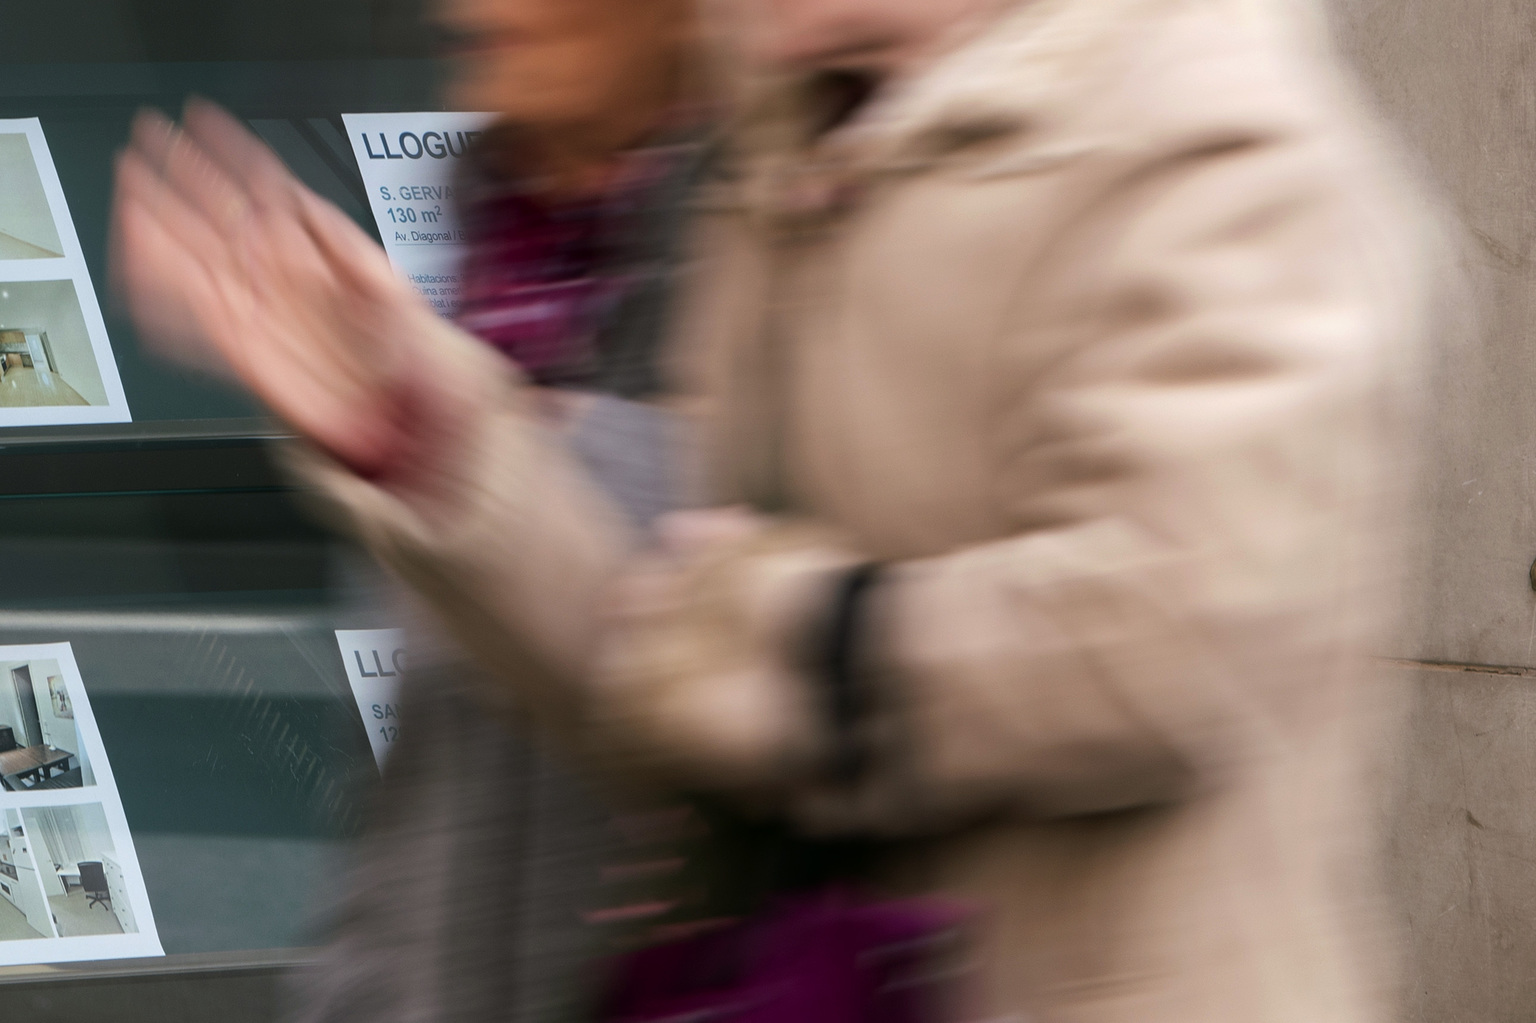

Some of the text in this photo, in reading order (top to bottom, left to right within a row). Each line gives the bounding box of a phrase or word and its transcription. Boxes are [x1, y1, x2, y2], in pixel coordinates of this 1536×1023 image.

[380, 186, 455, 200] S. GERVA
[387, 208, 417, 223] 130
[395, 231, 452, 243] Av. Diagonal
